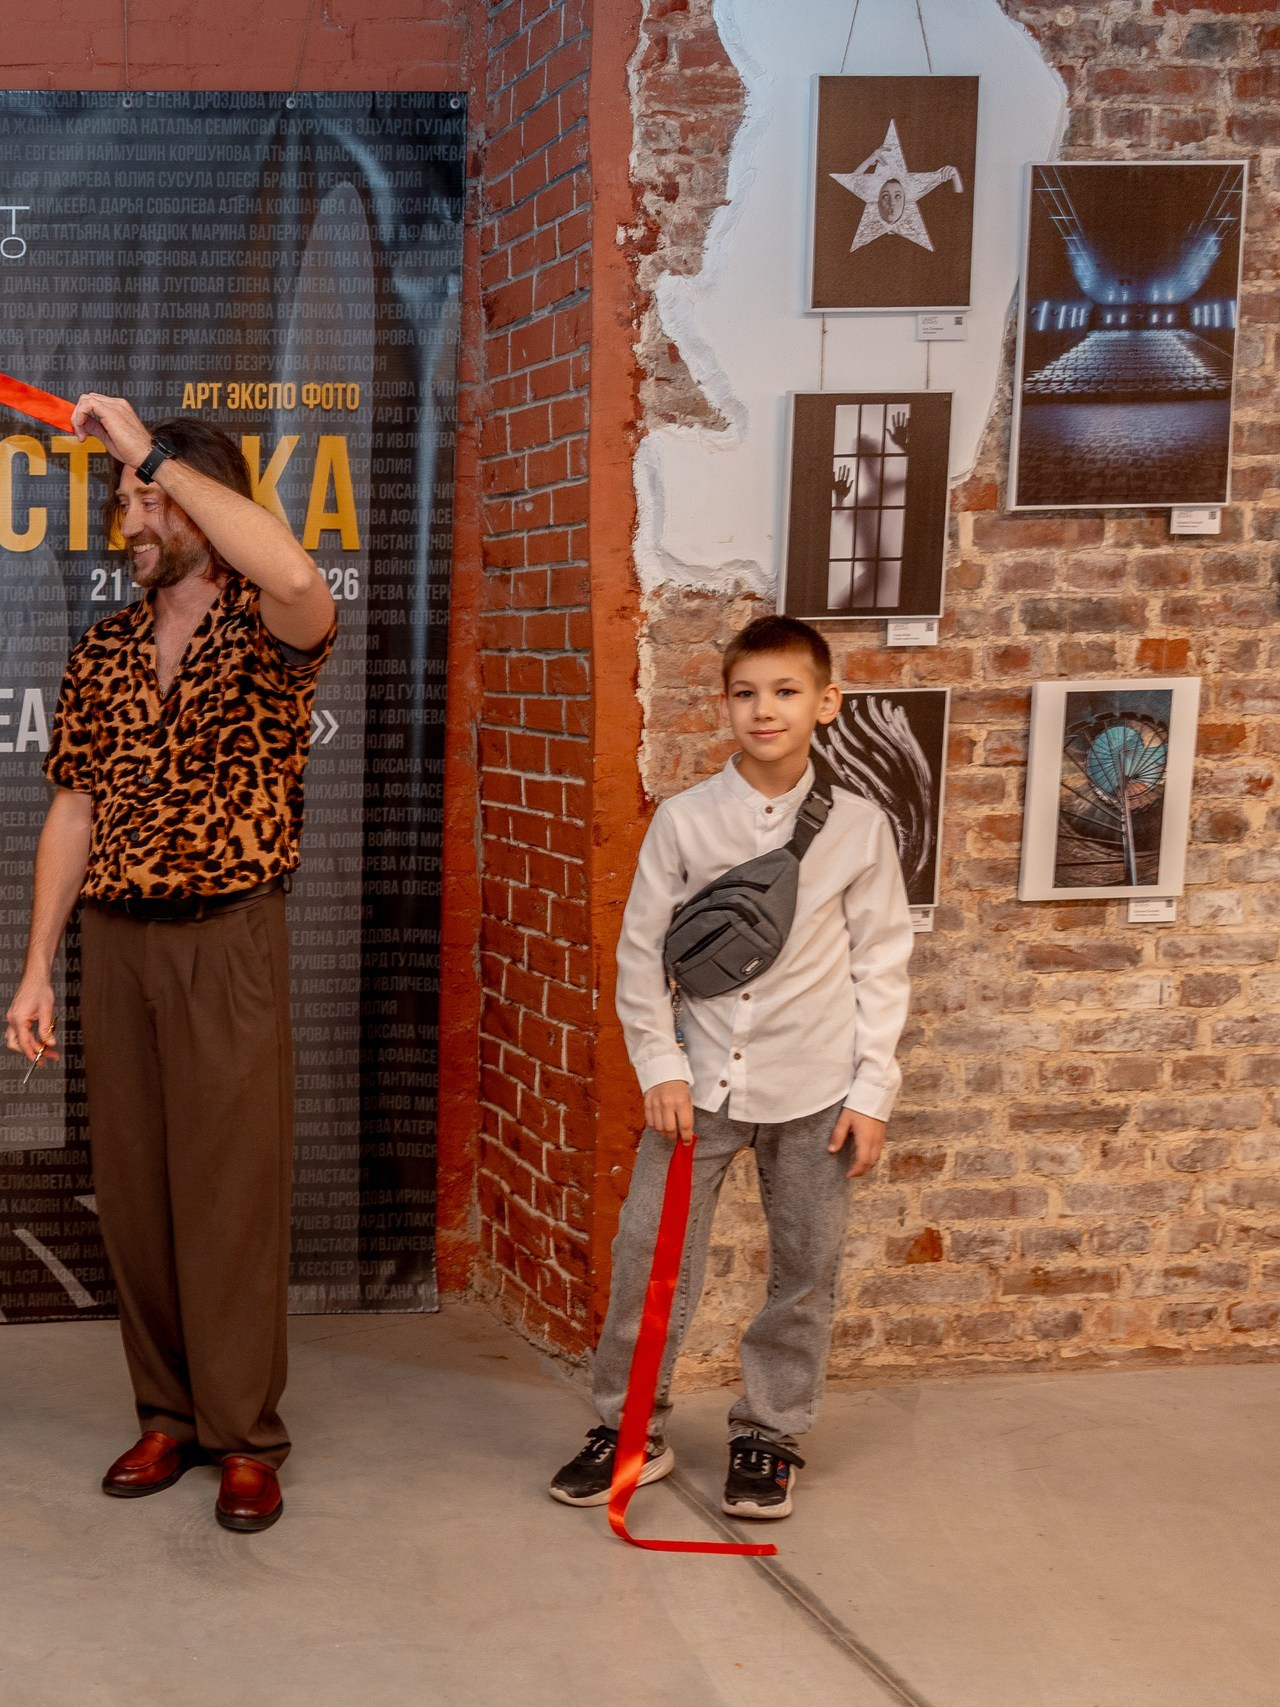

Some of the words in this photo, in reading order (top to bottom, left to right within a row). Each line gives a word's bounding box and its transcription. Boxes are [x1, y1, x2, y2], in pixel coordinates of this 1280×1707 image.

[141, 119, 202, 135] НАТАЛЬЯ
[205, 119, 275, 136] СЕМИКОВА
[356, 120, 412, 138] ЭДУАРД
[25, 142, 83, 161] ЕВГЕНИЙ
[169, 145, 251, 161] КОРШУНОВА
[254, 146, 311, 162] ТАТЬЯНА
[42, 171, 111, 187] ЛАЗАРЕВА
[158, 171, 214, 187] СУСУЛА
[217, 172, 260, 187] ОЛЕСЯ
[146, 198, 215, 214] СОБОЛЕВА
[54, 224, 108, 240] ТАТЬЯНА
[192, 225, 246, 240] МАРИНА
[200, 251, 287, 268] АЛЕКСАНДРА
[3, 276, 50, 294] ДИАНА
[53, 276, 121, 292] ТИХОНОВА
[124, 277, 159, 292] АННА
[163, 277, 224, 293] ЛУГОВАЯ
[228, 277, 270, 293] ЕЛЕНА
[153, 303, 210, 319] ТАТЬЯНА
[173, 329, 242, 345] ЕРМАКОВА
[182, 383, 221, 409] АРТ
[227, 382, 295, 410] ЭКСПО
[302, 382, 360, 410] ФОТО
